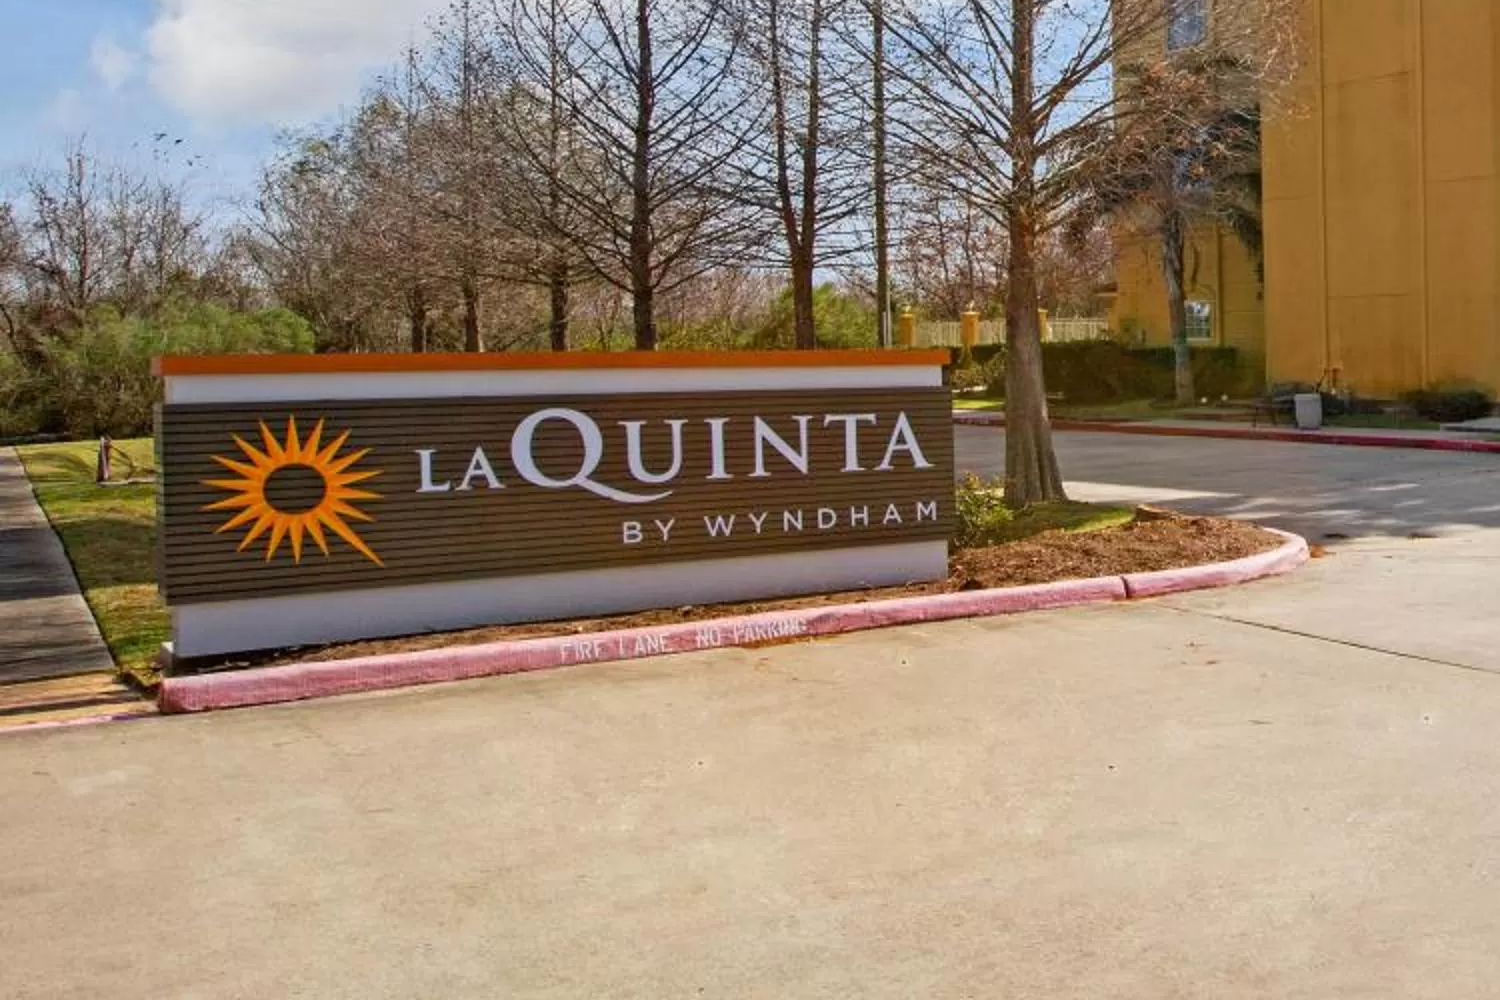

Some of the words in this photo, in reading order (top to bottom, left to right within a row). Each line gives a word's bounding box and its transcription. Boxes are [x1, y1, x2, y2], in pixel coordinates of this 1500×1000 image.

[414, 446, 505, 493] LA
[510, 407, 935, 502] QUINTA
[622, 518, 676, 543] BY
[703, 501, 937, 537] WYNDHAM
[560, 638, 602, 662] FIRE
[618, 633, 672, 656] LANE
[695, 626, 722, 648] NO
